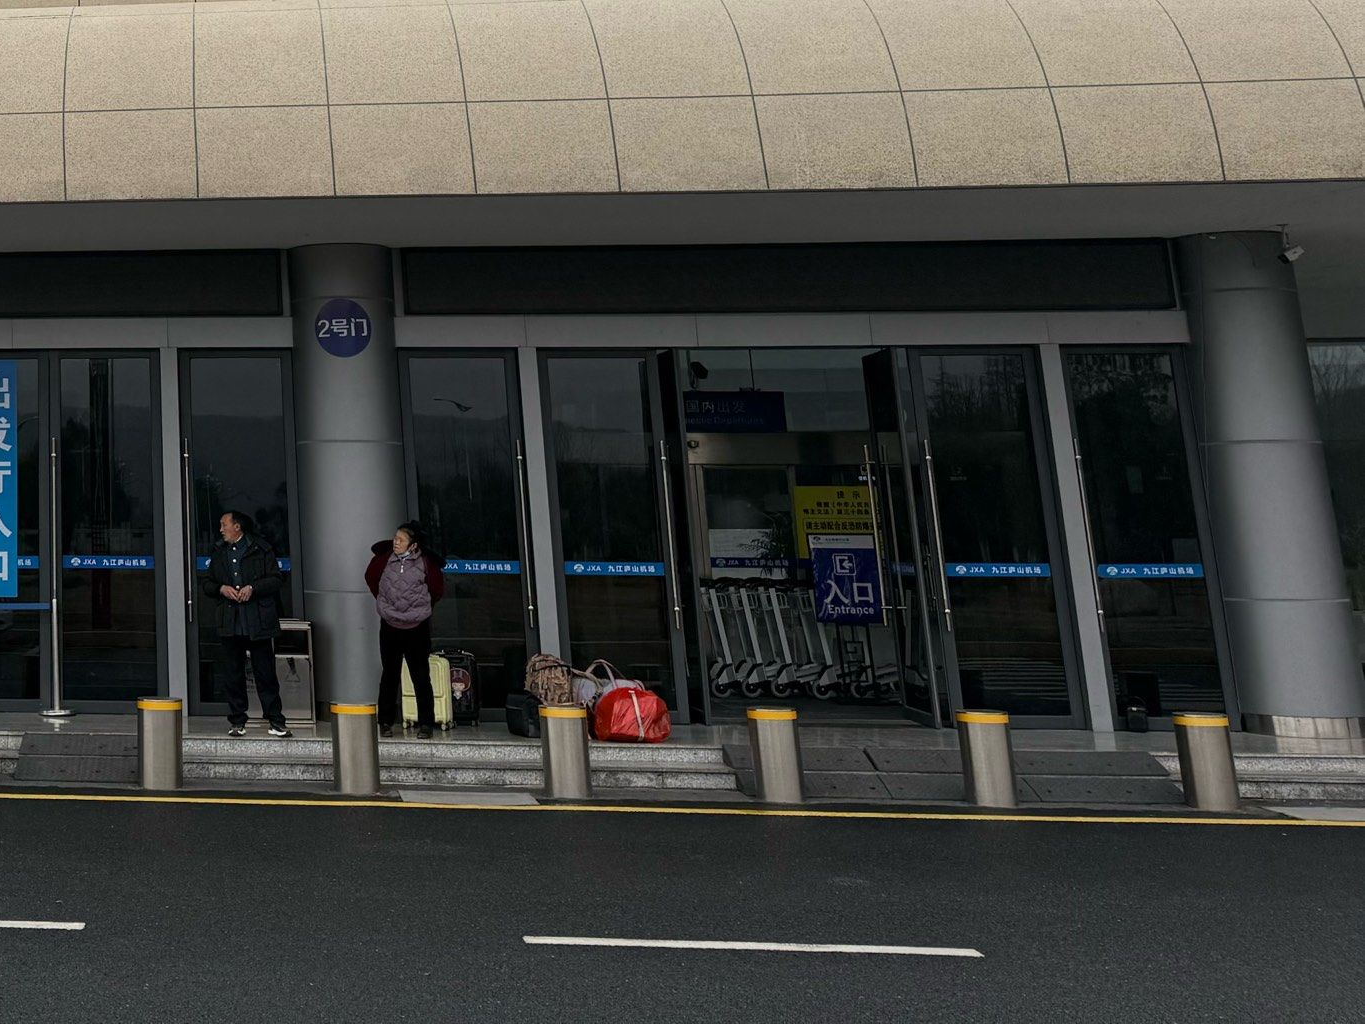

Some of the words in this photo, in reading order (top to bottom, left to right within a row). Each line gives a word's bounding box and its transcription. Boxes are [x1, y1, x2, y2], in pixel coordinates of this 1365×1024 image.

[318, 317, 368, 337] 2号门
[686, 399, 747, 414] 国内出发
[102, 559, 147, 567] 九江庐山机场
[464, 563, 512, 571] 九江庐山机场
[607, 565, 656, 573] 九江庐山机场
[969, 565, 985, 574] JXA
[991, 566, 1042, 574] 九江庐山机场
[1120, 567, 1137, 575] JXA
[1142, 567, 1195, 576] 九江庐山机场
[823, 580, 875, 604] 入口
[828, 604, 875, 615] Entrance
